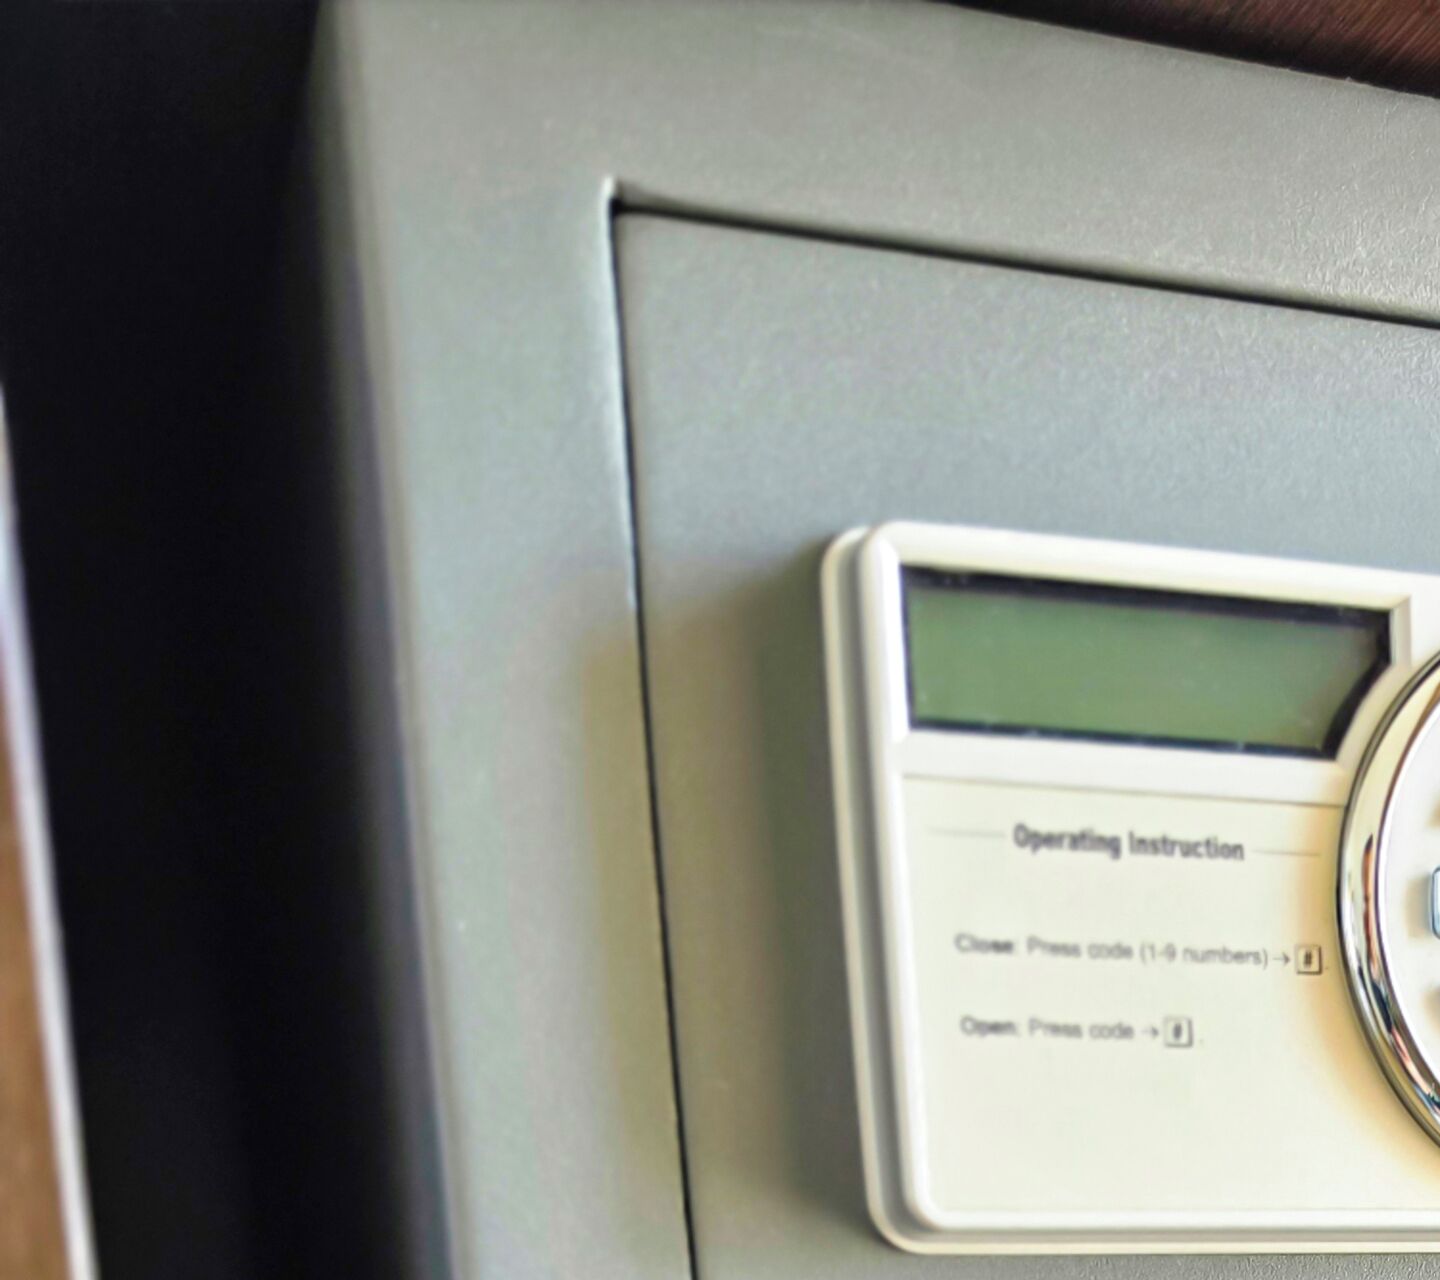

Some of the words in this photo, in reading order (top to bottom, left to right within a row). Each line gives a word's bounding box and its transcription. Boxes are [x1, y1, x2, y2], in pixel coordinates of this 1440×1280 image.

[1013, 822, 1123, 860] Operating
[1128, 830, 1245, 861] Instruction
[1026, 934, 1083, 958] Press
[1087, 941, 1134, 960] code
[1139, 942, 1178, 966] (1-9
[1182, 946, 1269, 971] numbers)
[1028, 1017, 1083, 1039] Press
[1089, 1021, 1135, 1040] code
